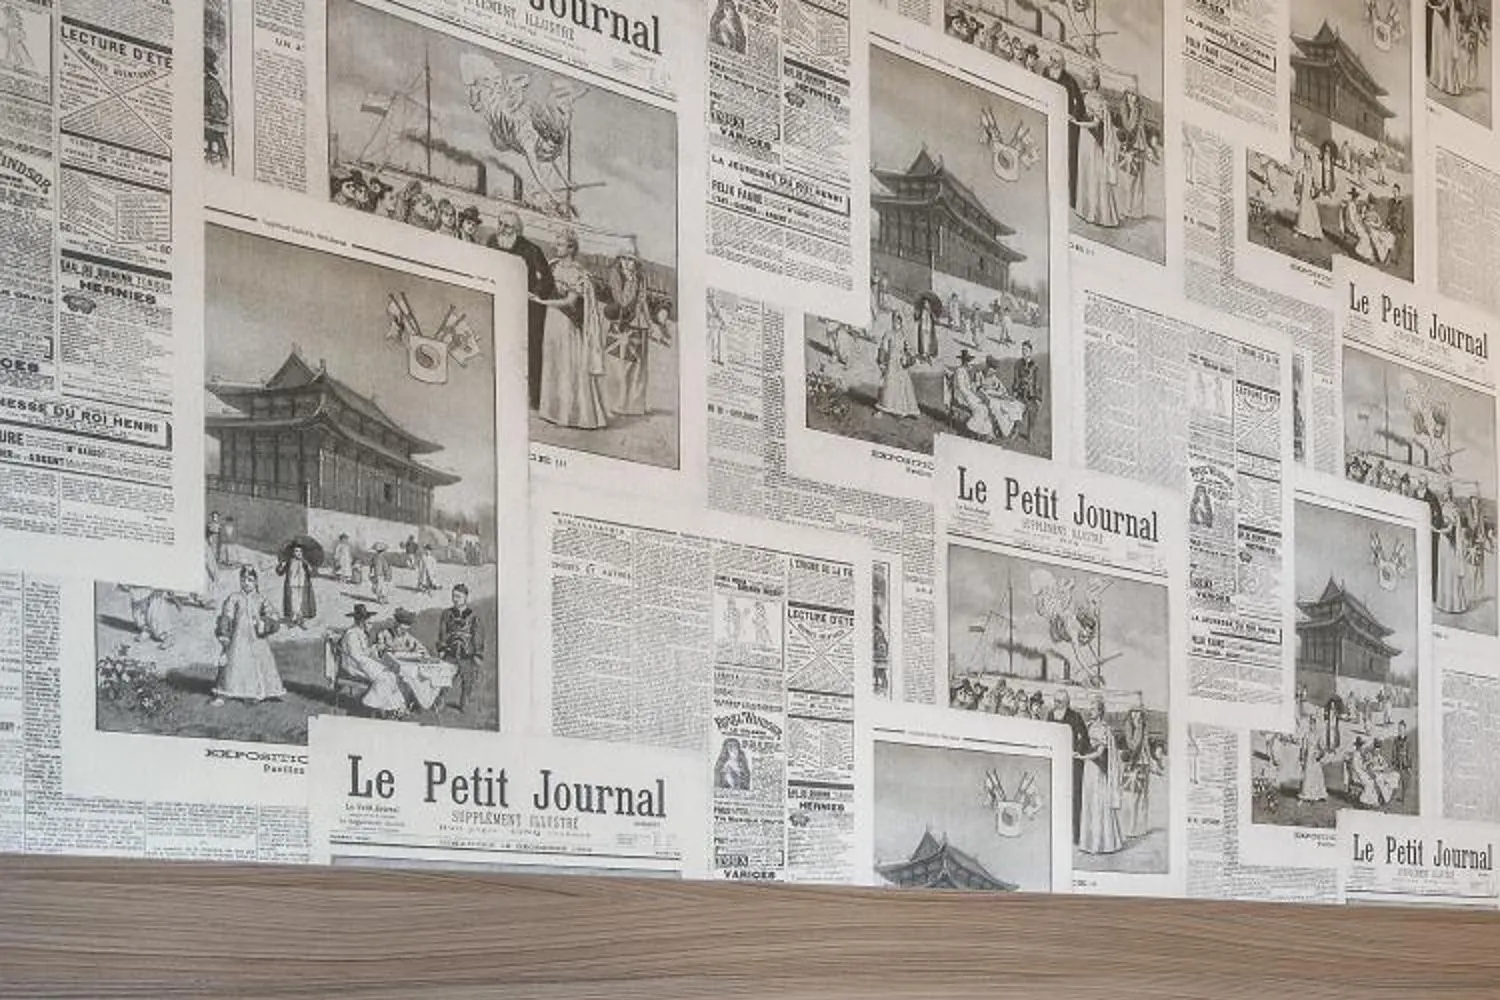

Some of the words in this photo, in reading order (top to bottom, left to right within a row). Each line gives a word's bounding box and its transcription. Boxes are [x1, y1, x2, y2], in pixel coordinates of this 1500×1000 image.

[529, 0, 662, 54] ournal
[1350, 281, 1370, 314] Le
[1381, 293, 1420, 334] Petit
[1429, 313, 1488, 359] Journal
[958, 466, 987, 504] Le
[1005, 477, 1059, 521] Petit
[1073, 493, 1159, 543] Journal
[348, 755, 395, 799] Le
[423, 760, 508, 808] Petit
[533, 769, 666, 818] Journal
[1353, 833, 1374, 862] Le
[1386, 835, 1424, 867] Petit
[1433, 839, 1493, 871] Journal
